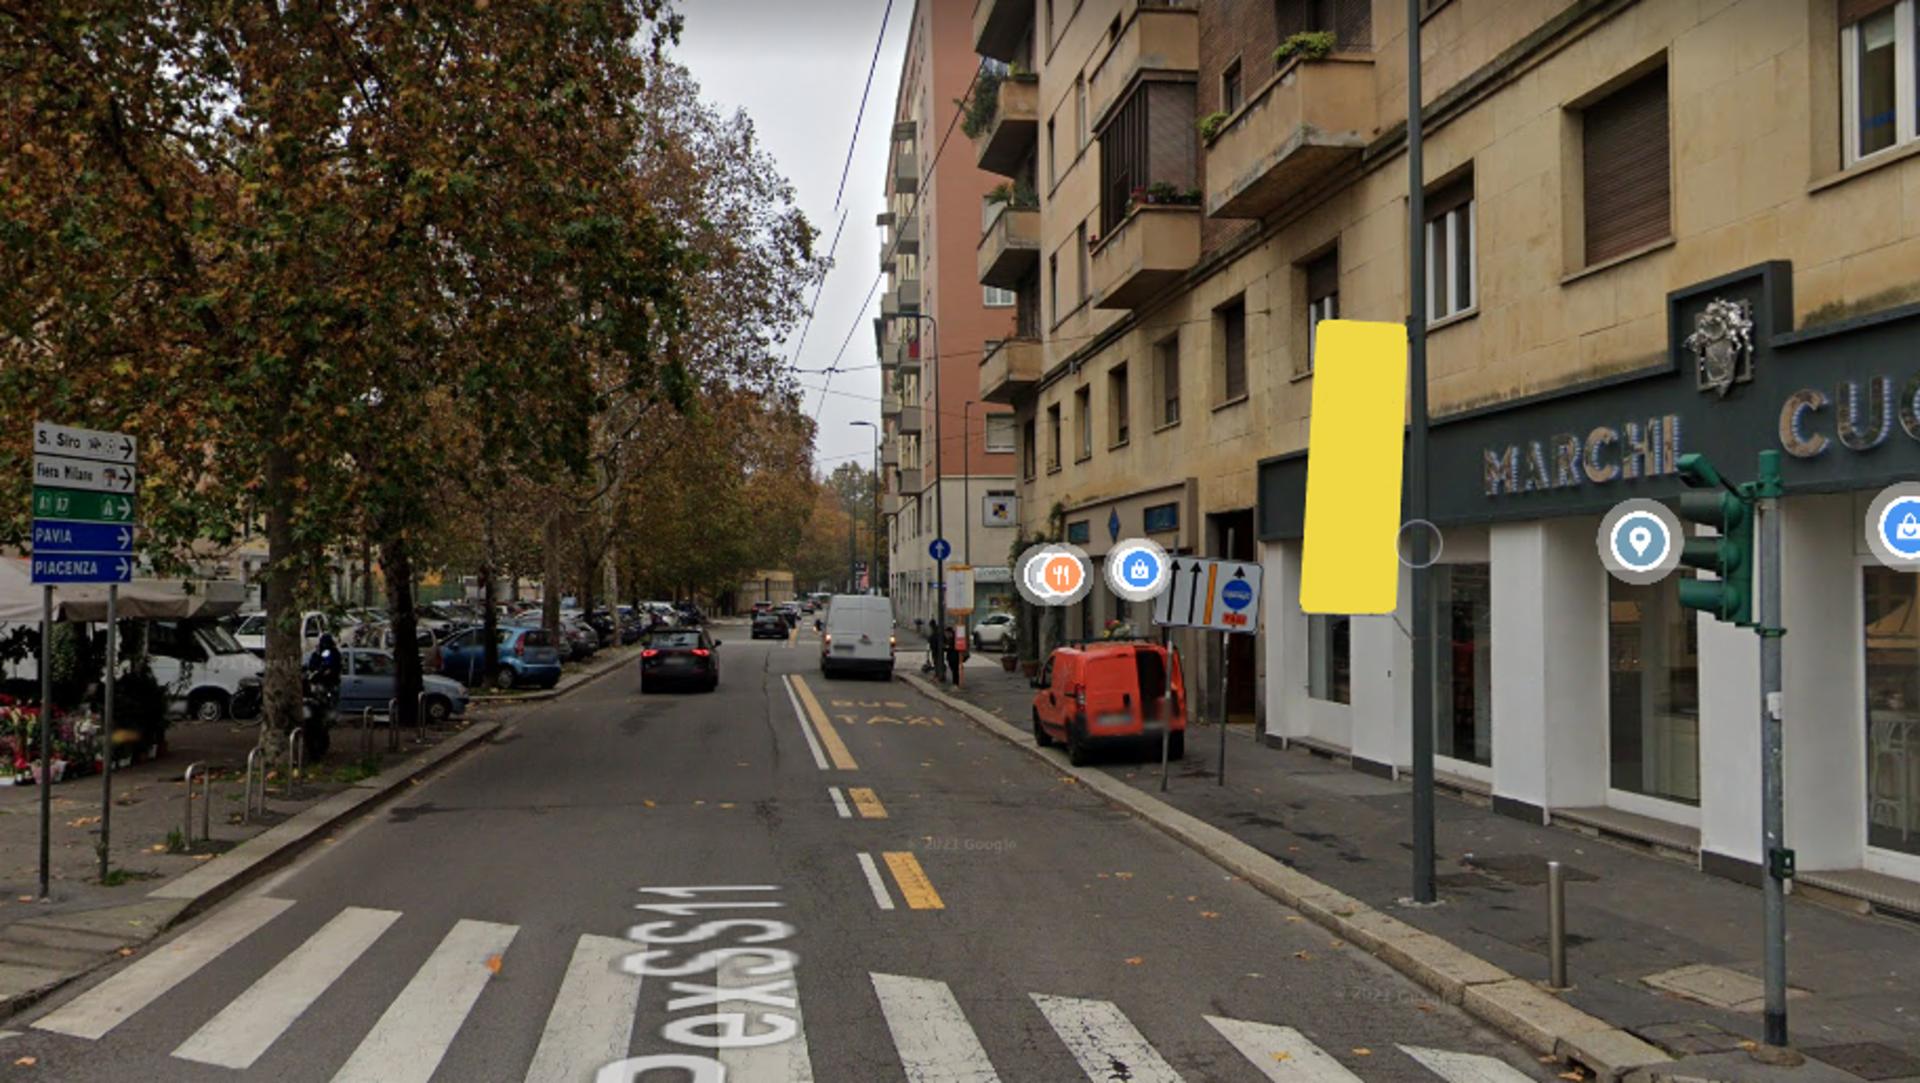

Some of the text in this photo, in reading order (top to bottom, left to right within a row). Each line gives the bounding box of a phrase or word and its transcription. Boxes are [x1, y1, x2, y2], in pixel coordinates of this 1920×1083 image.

[38, 430, 81, 449] S. Siro
[1483, 413, 1681, 497] MARCHI
[37, 462, 93, 482] Fiera Milano
[55, 497, 69, 513] A7
[35, 528, 73, 543] PAVIA
[35, 560, 98, 575] PIACENZA
[830, 700, 907, 708] BUS
[835, 714, 945, 726] TAXI
